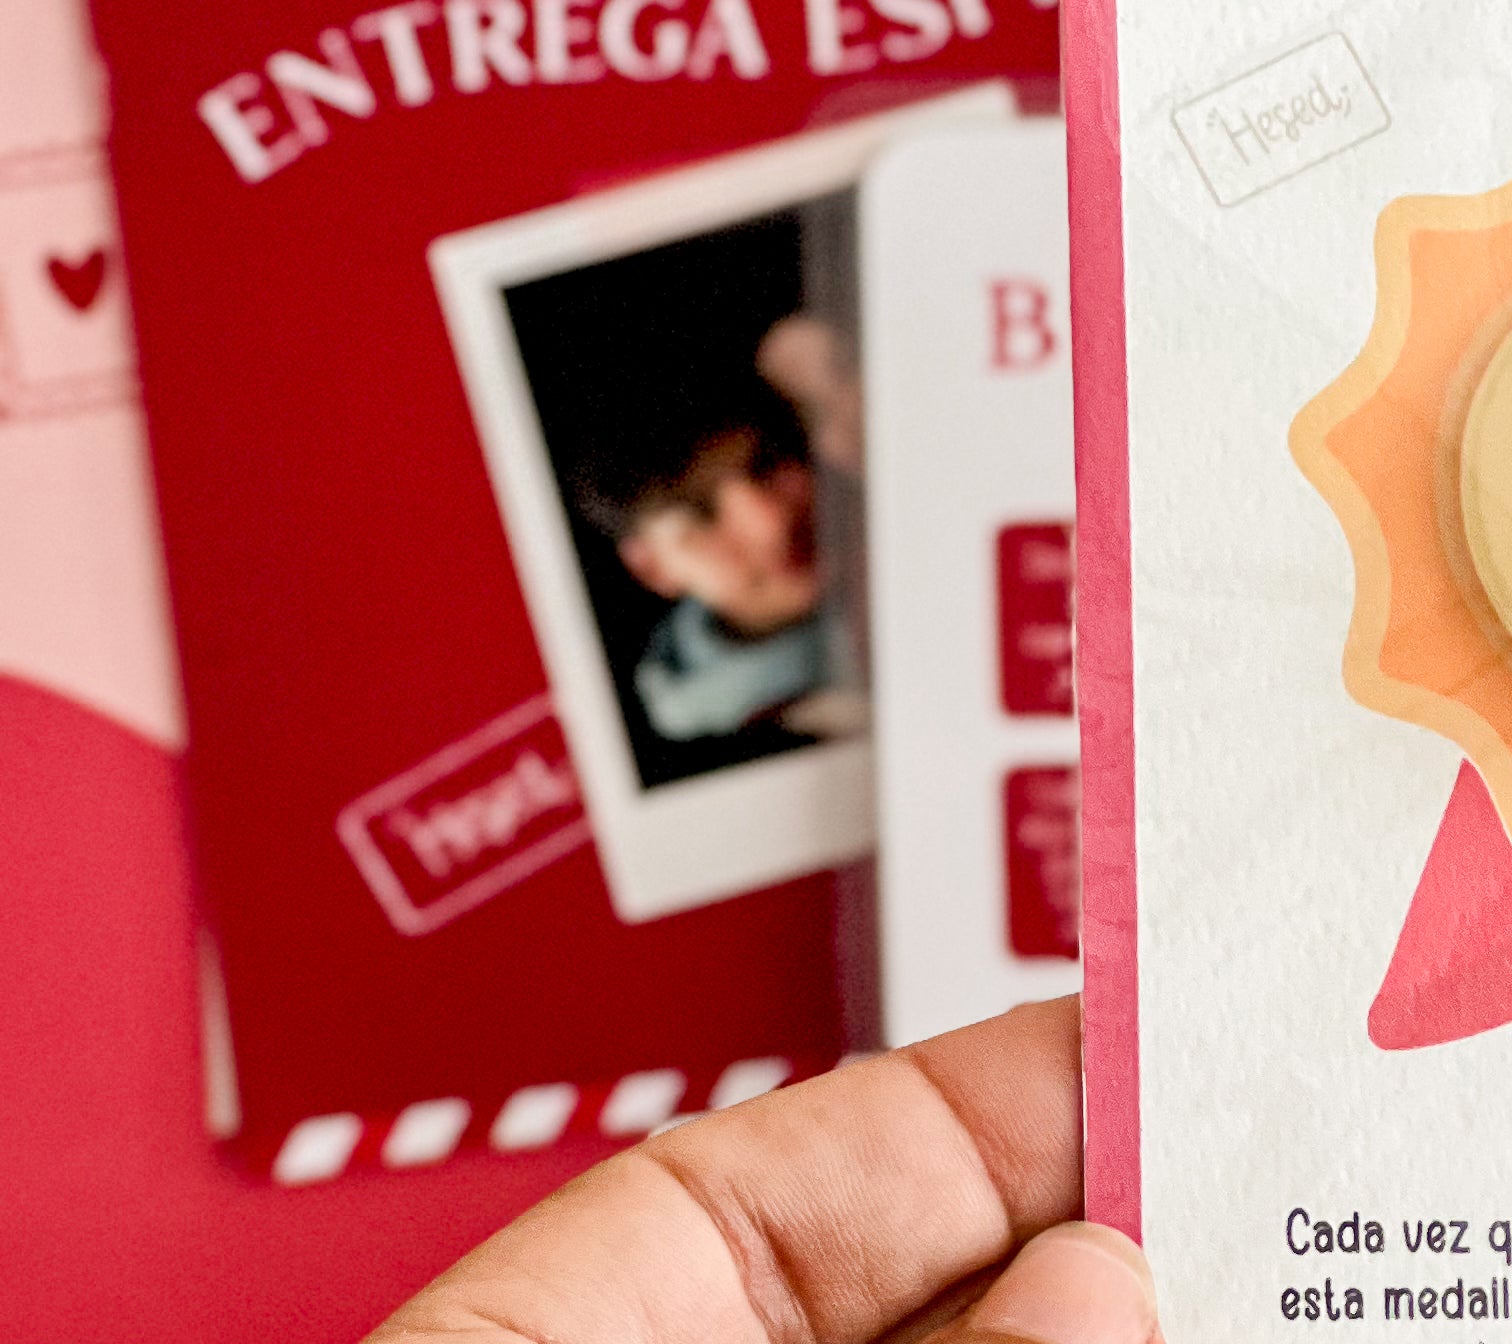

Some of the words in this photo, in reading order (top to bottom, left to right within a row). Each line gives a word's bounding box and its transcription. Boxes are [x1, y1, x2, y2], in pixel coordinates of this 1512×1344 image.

[1287, 1208, 1384, 1255] Cada
[1403, 1221, 1470, 1253] vez
[1281, 1277, 1364, 1321] esta
